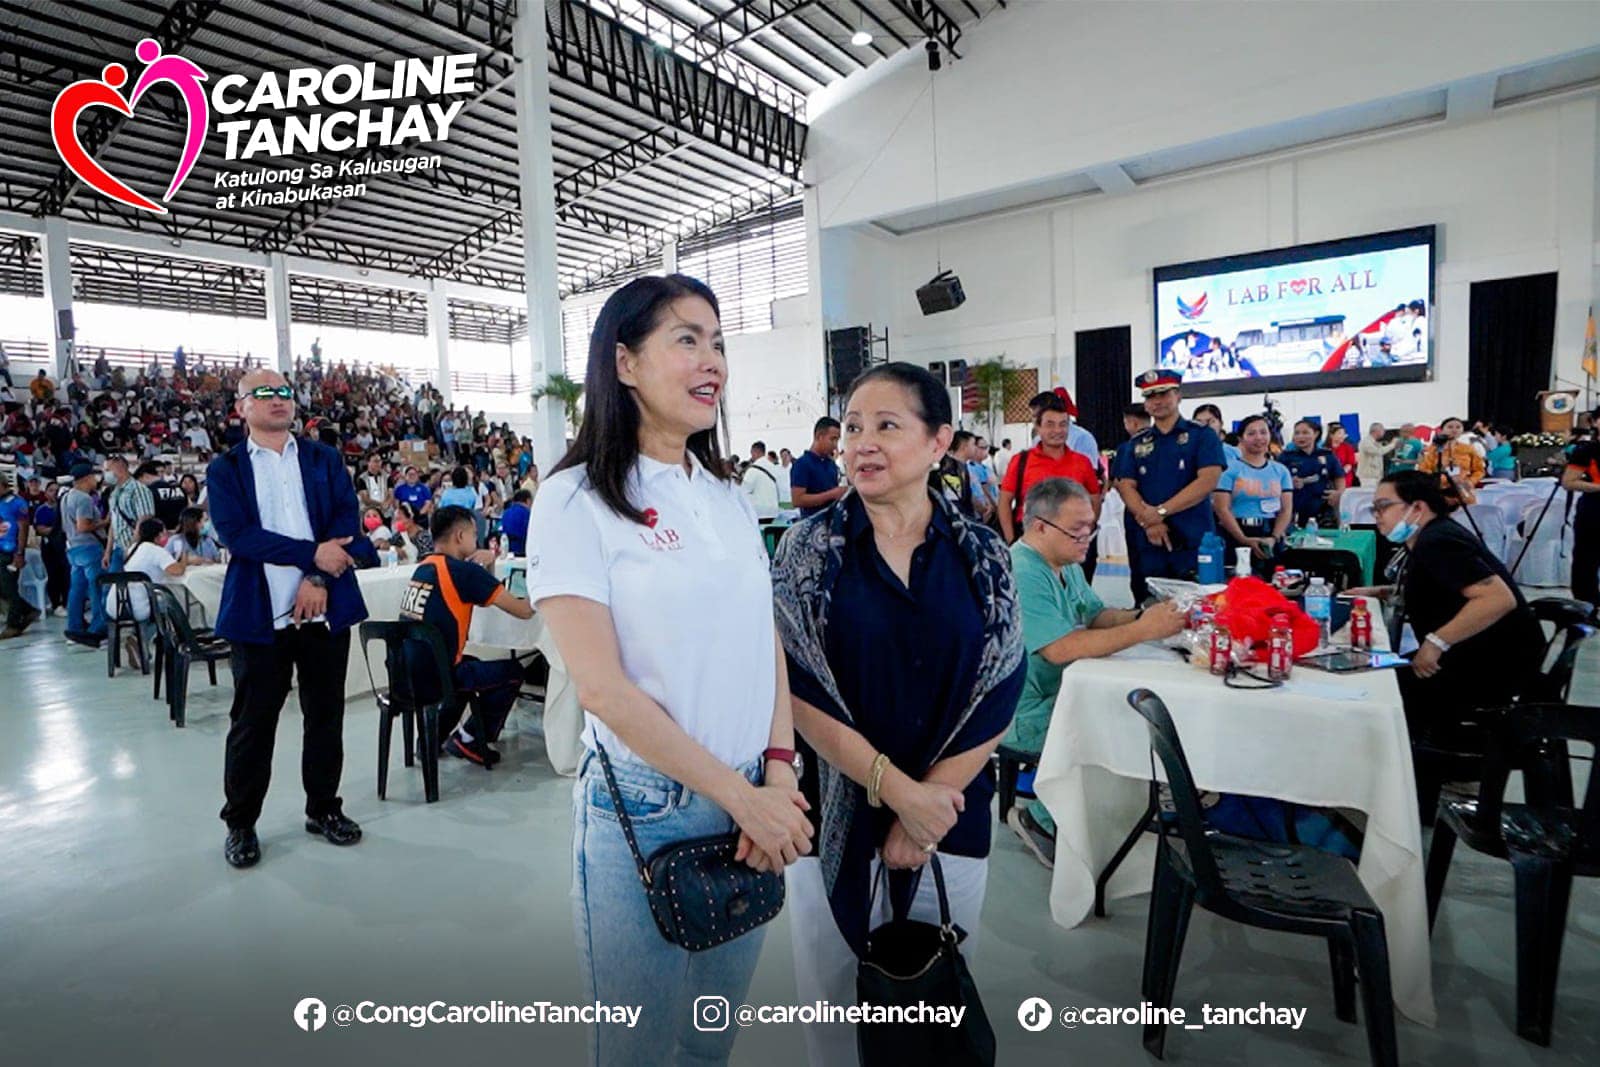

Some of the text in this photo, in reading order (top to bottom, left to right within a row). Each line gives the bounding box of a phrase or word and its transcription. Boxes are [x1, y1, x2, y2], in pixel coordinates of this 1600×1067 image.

[1227, 284, 1269, 306] LAB
[1331, 270, 1377, 292] ALL
[638, 529, 680, 546] LAB
